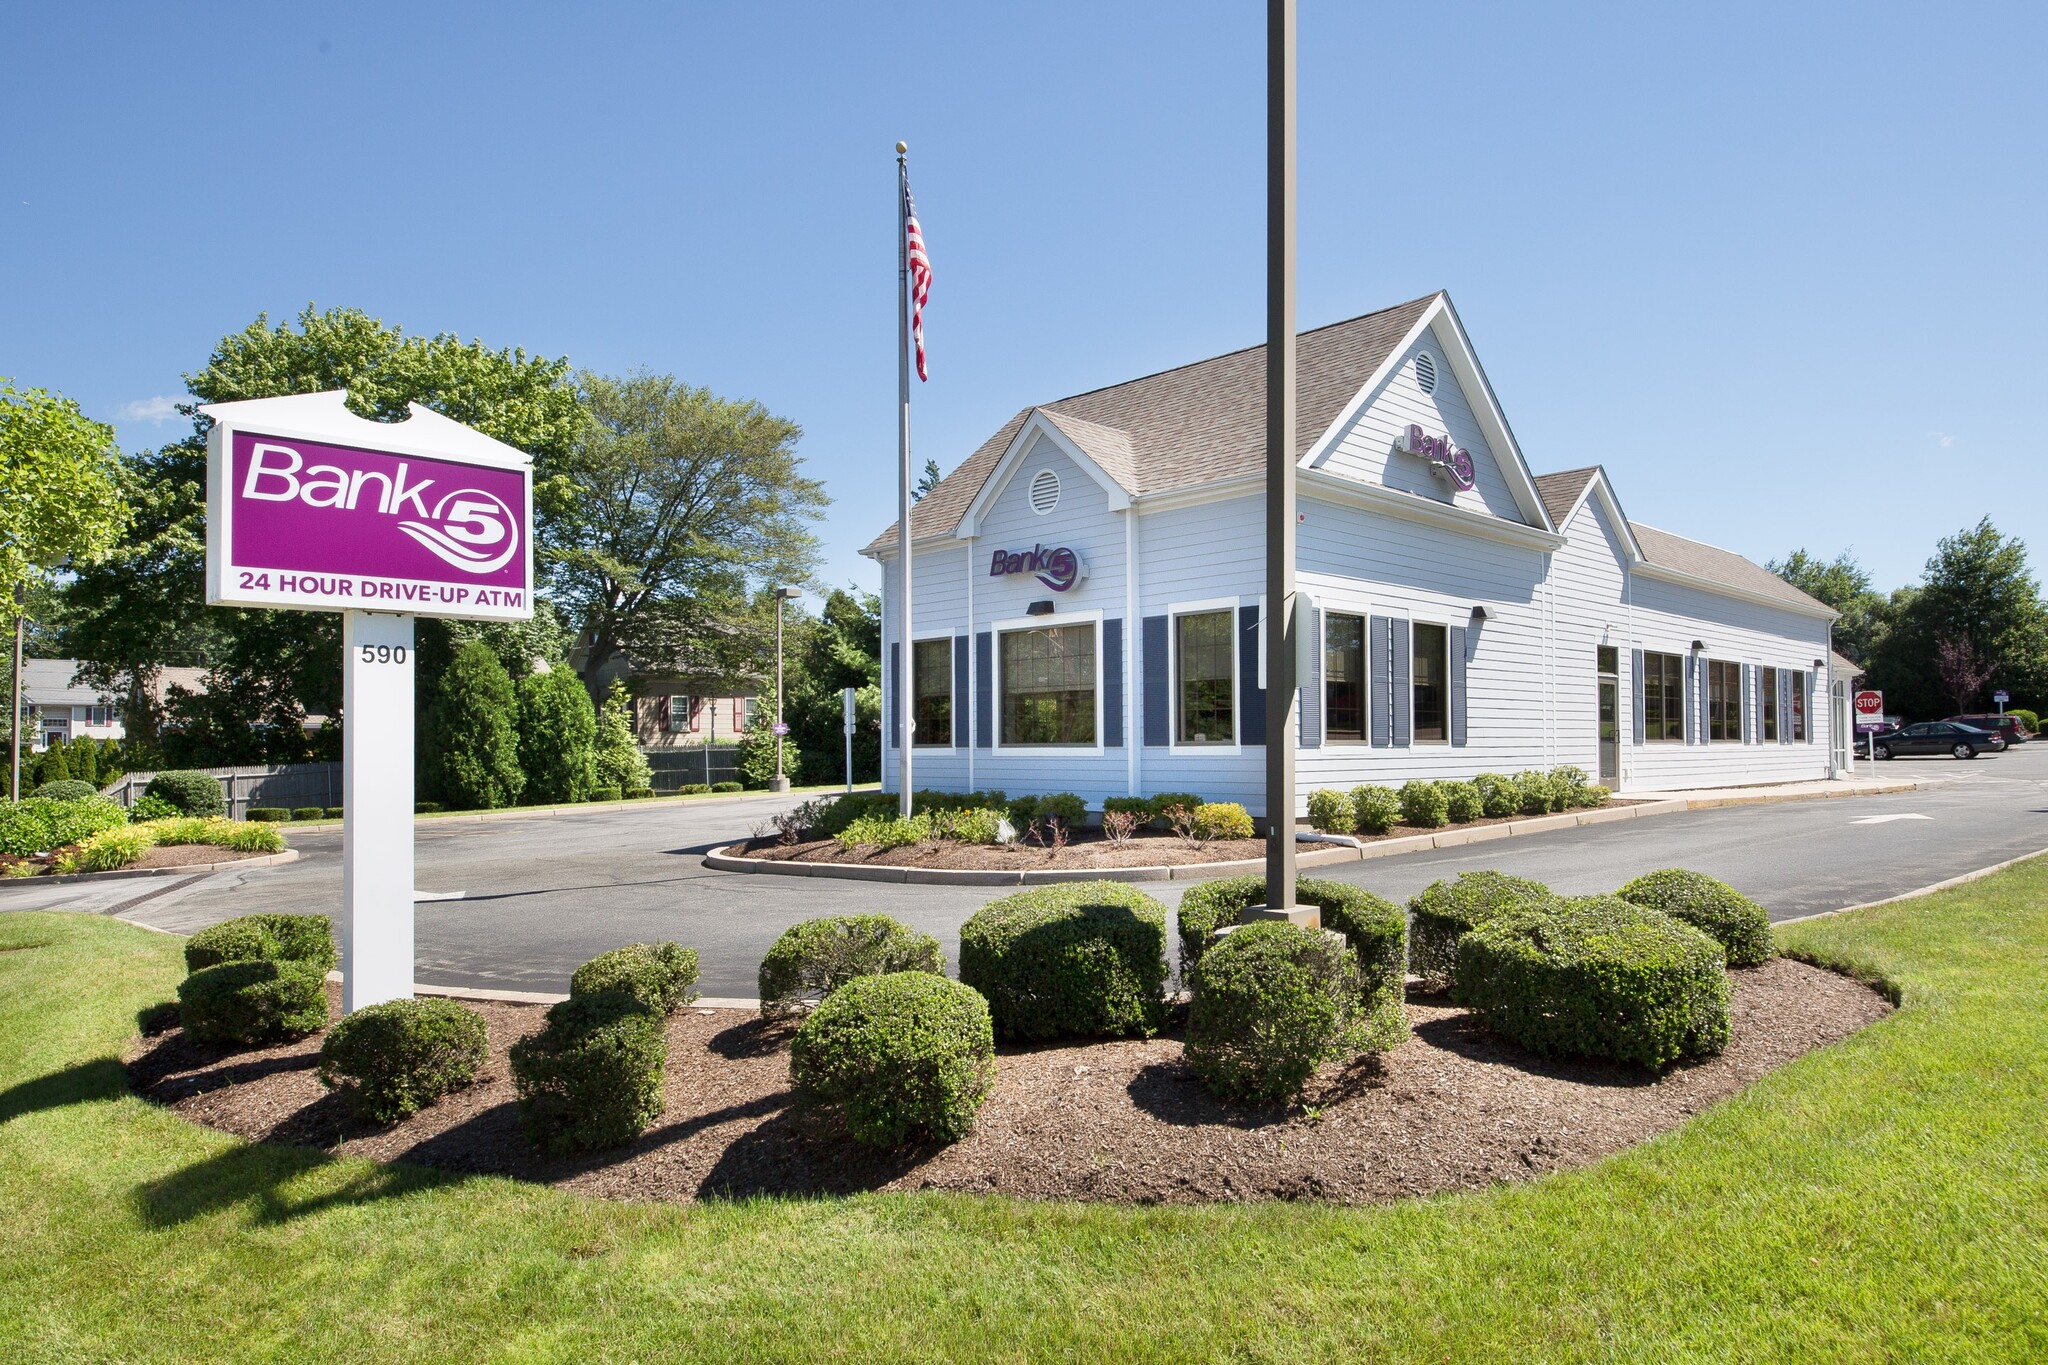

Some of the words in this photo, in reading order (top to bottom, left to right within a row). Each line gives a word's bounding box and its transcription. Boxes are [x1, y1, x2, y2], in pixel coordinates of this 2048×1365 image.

[239, 572, 271, 591] 24
[279, 574, 353, 597] HOUR
[361, 581, 470, 603] DRIVE-UP
[474, 590, 522, 608] ATM
[361, 644, 407, 665] 590
[1857, 697, 1880, 708] STOP
